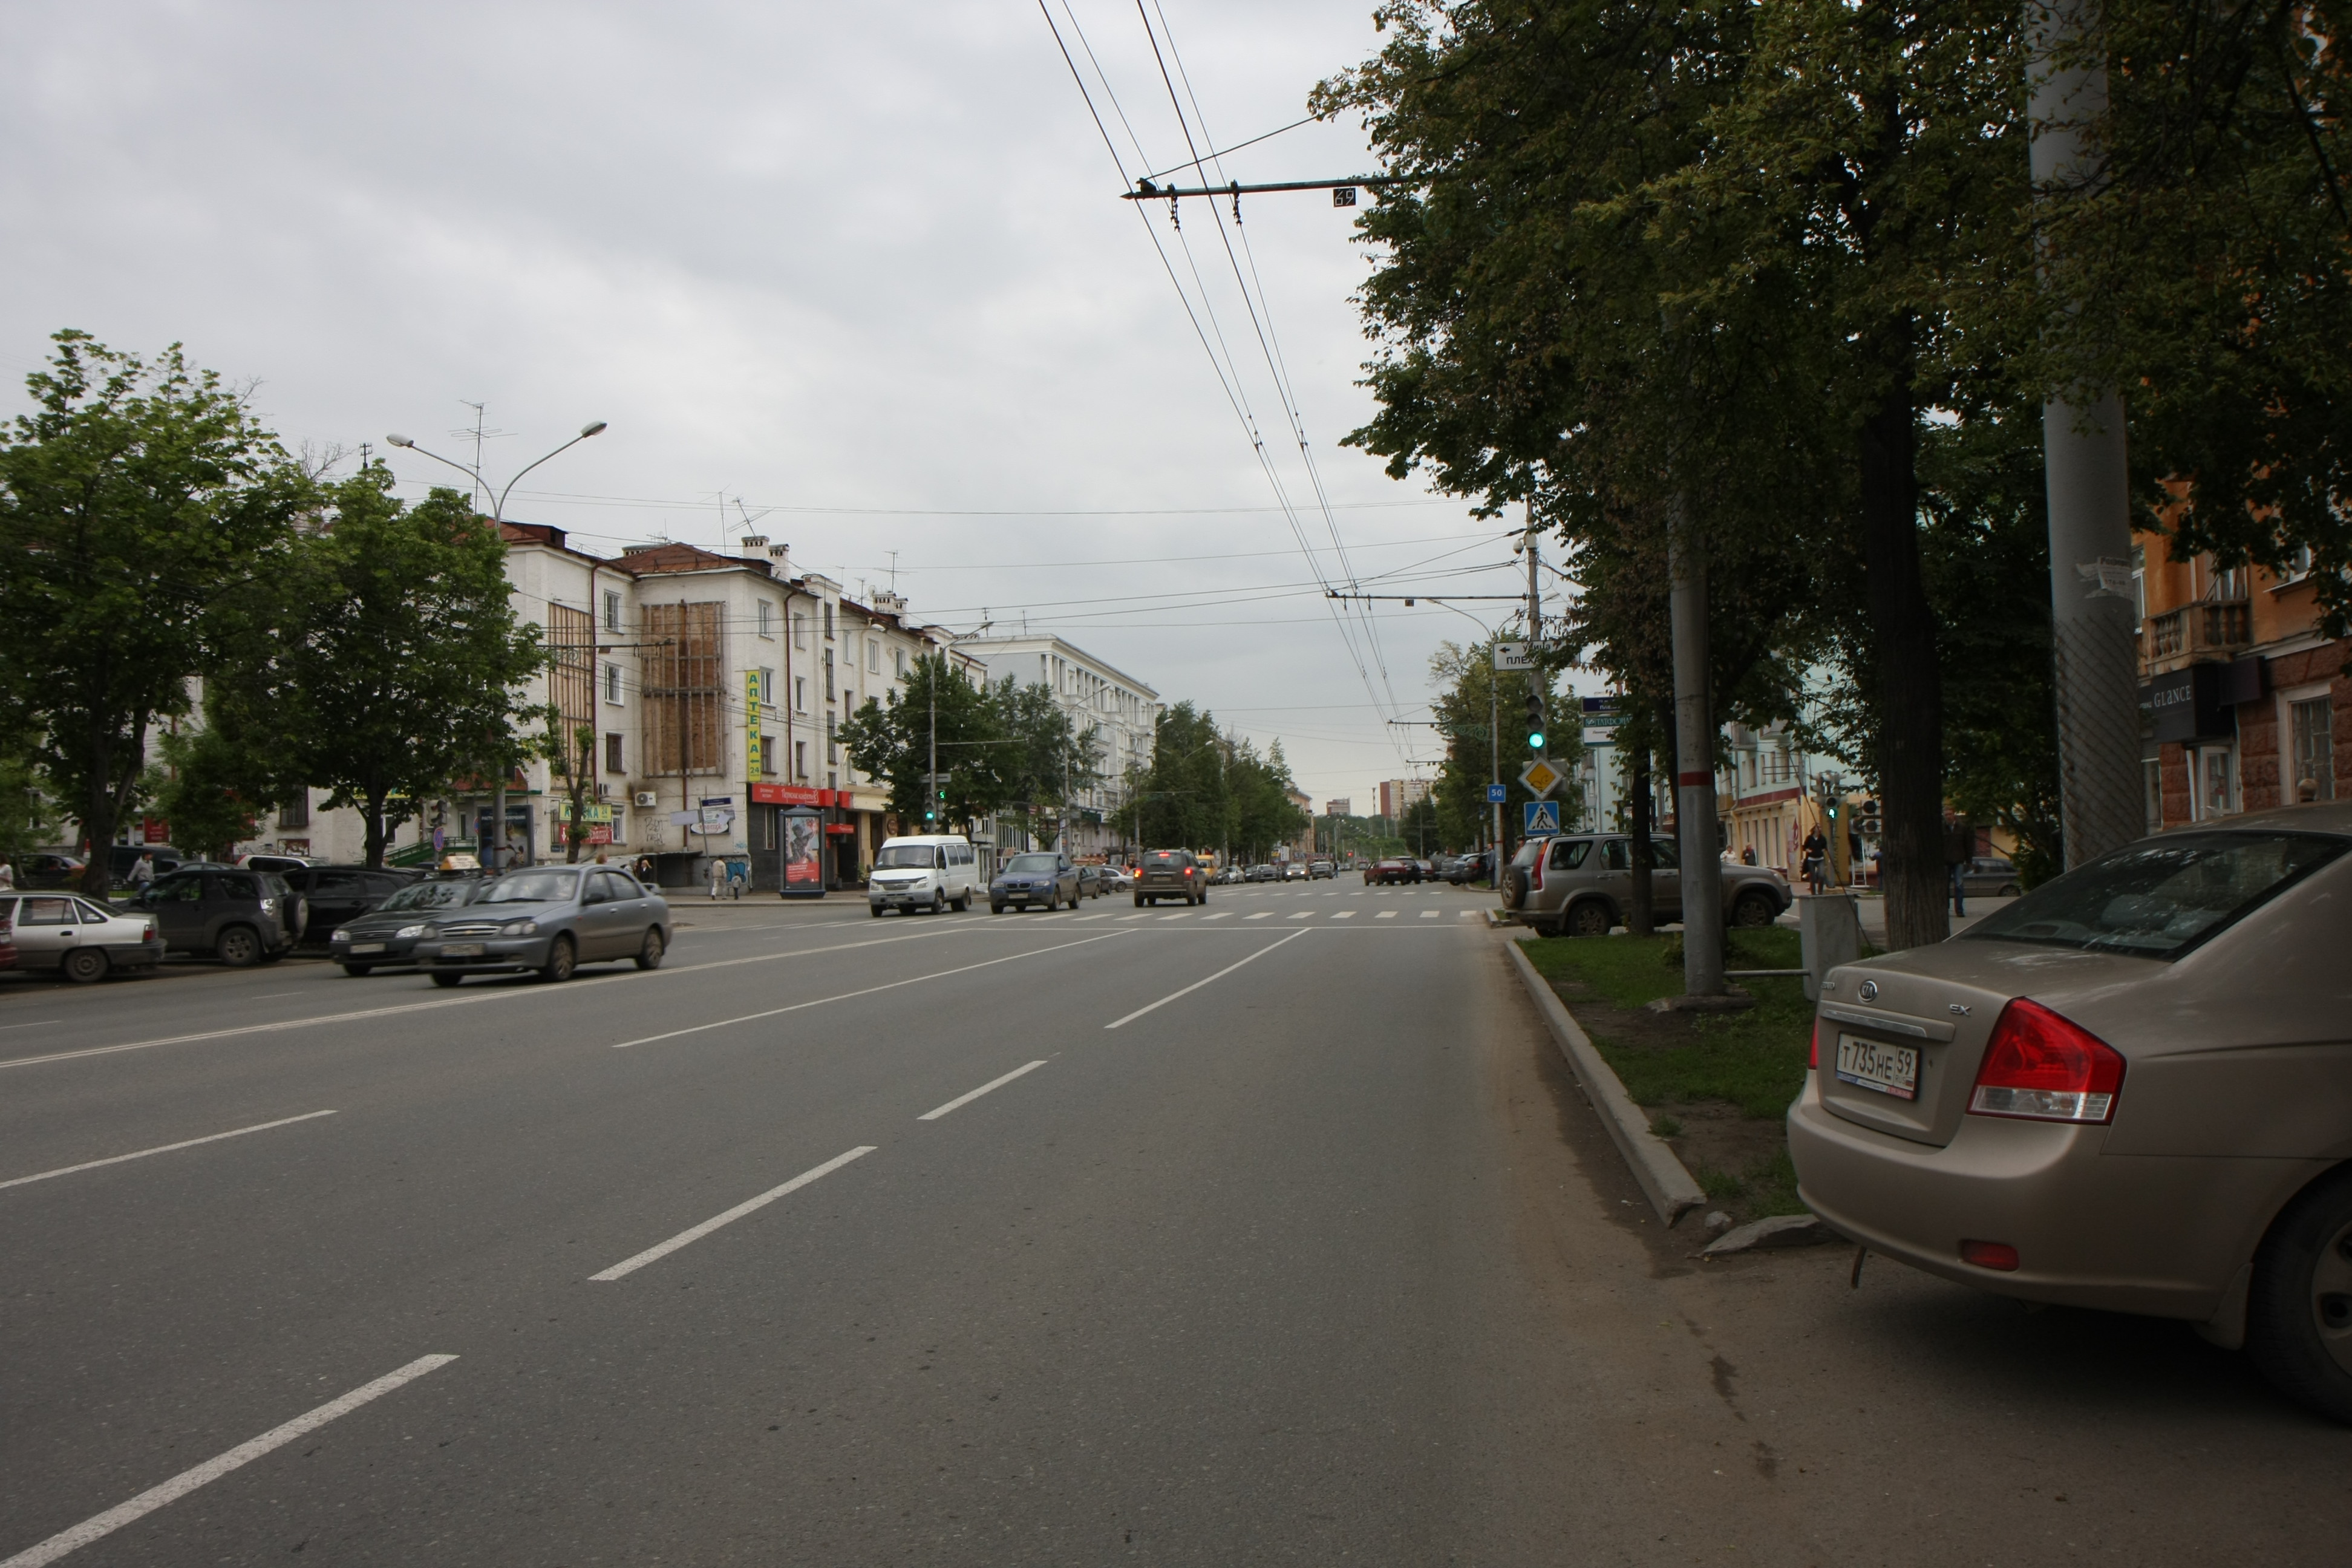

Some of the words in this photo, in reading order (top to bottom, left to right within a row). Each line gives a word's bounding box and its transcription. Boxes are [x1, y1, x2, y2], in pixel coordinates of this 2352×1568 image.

[1335, 190, 1354, 206] 69
[748, 674, 759, 753] АПТЕКА
[1950, 1004, 1971, 1016] EX
